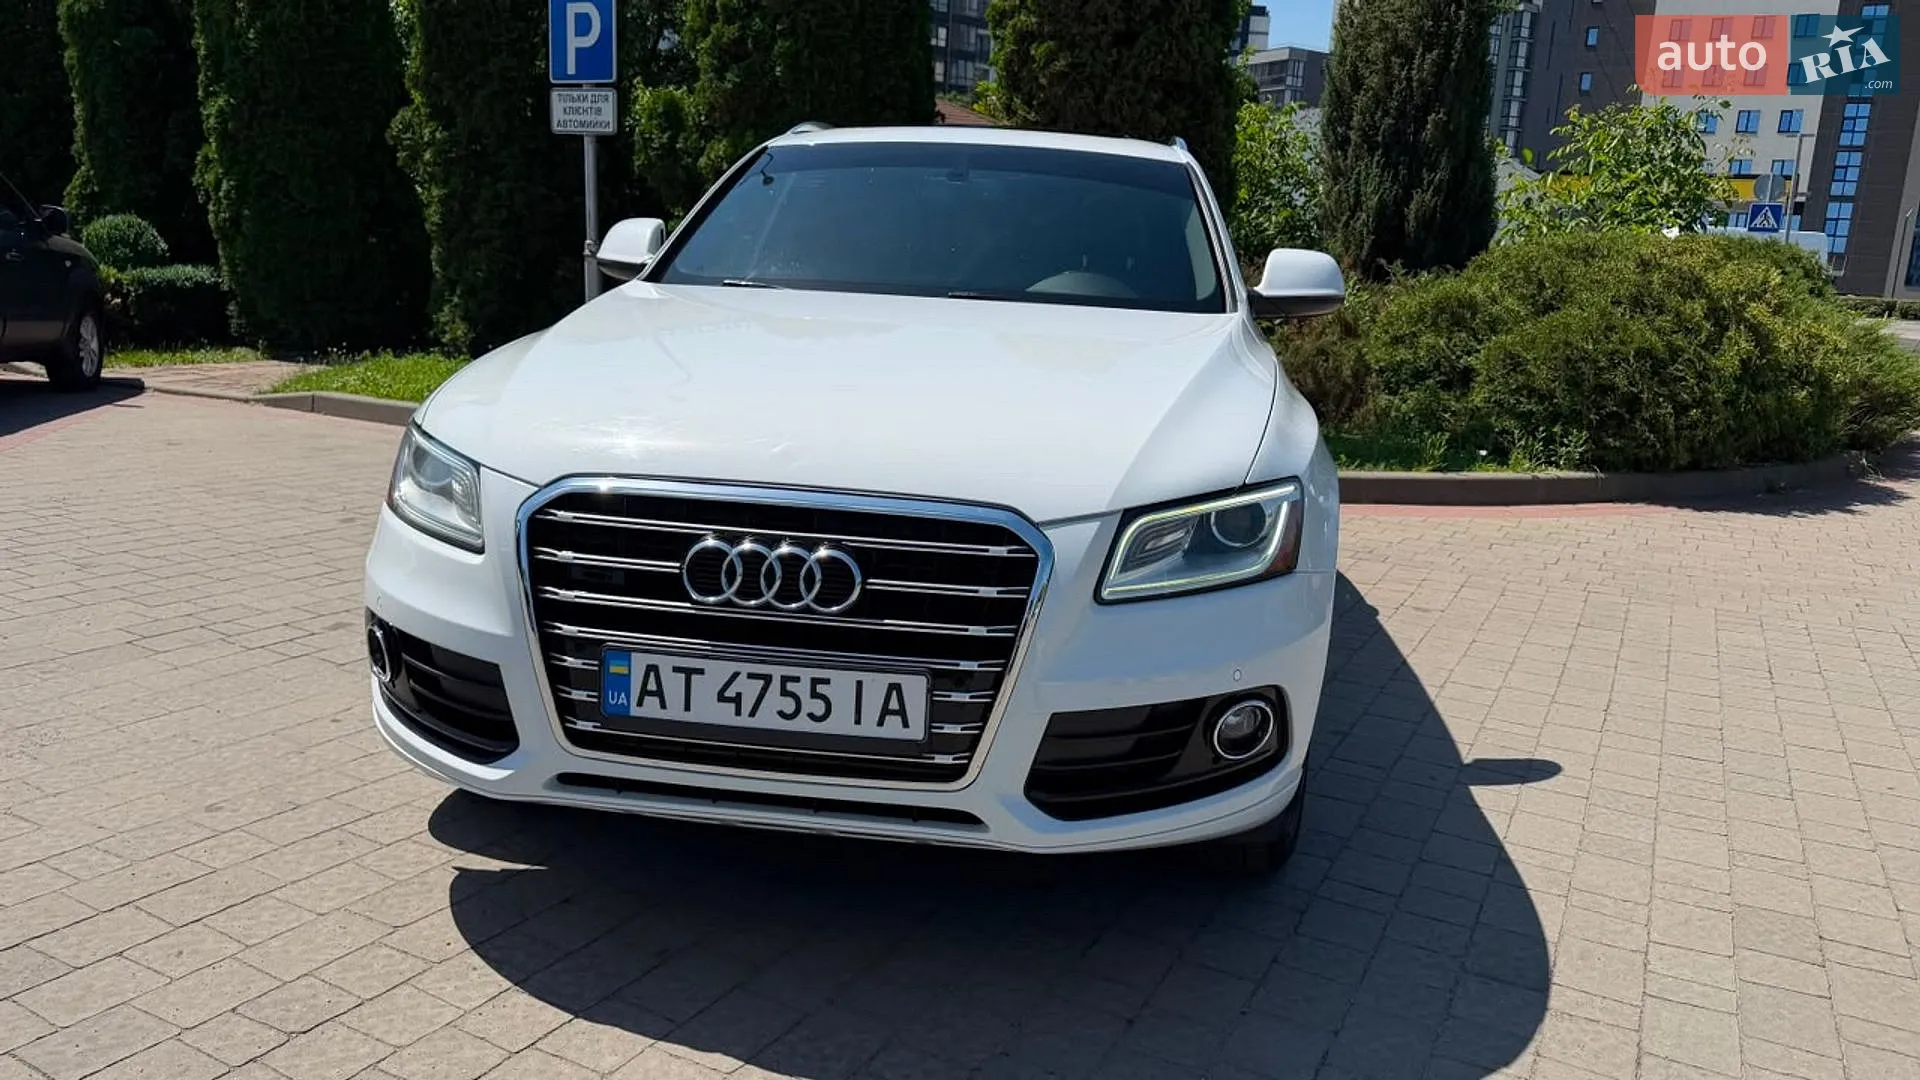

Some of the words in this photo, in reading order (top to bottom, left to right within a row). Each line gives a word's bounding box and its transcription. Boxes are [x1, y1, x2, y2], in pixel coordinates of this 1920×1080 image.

[566, 2, 601, 75] P
[557, 93, 588, 104] ТІЛЬКИ
[590, 93, 609, 104] ДЛЯ
[563, 106, 603, 116] КЛІЄНТІВ
[608, 689, 628, 707] UA
[636, 664, 705, 712] AT
[716, 671, 832, 723] 4755
[854, 680, 910, 729] IA
